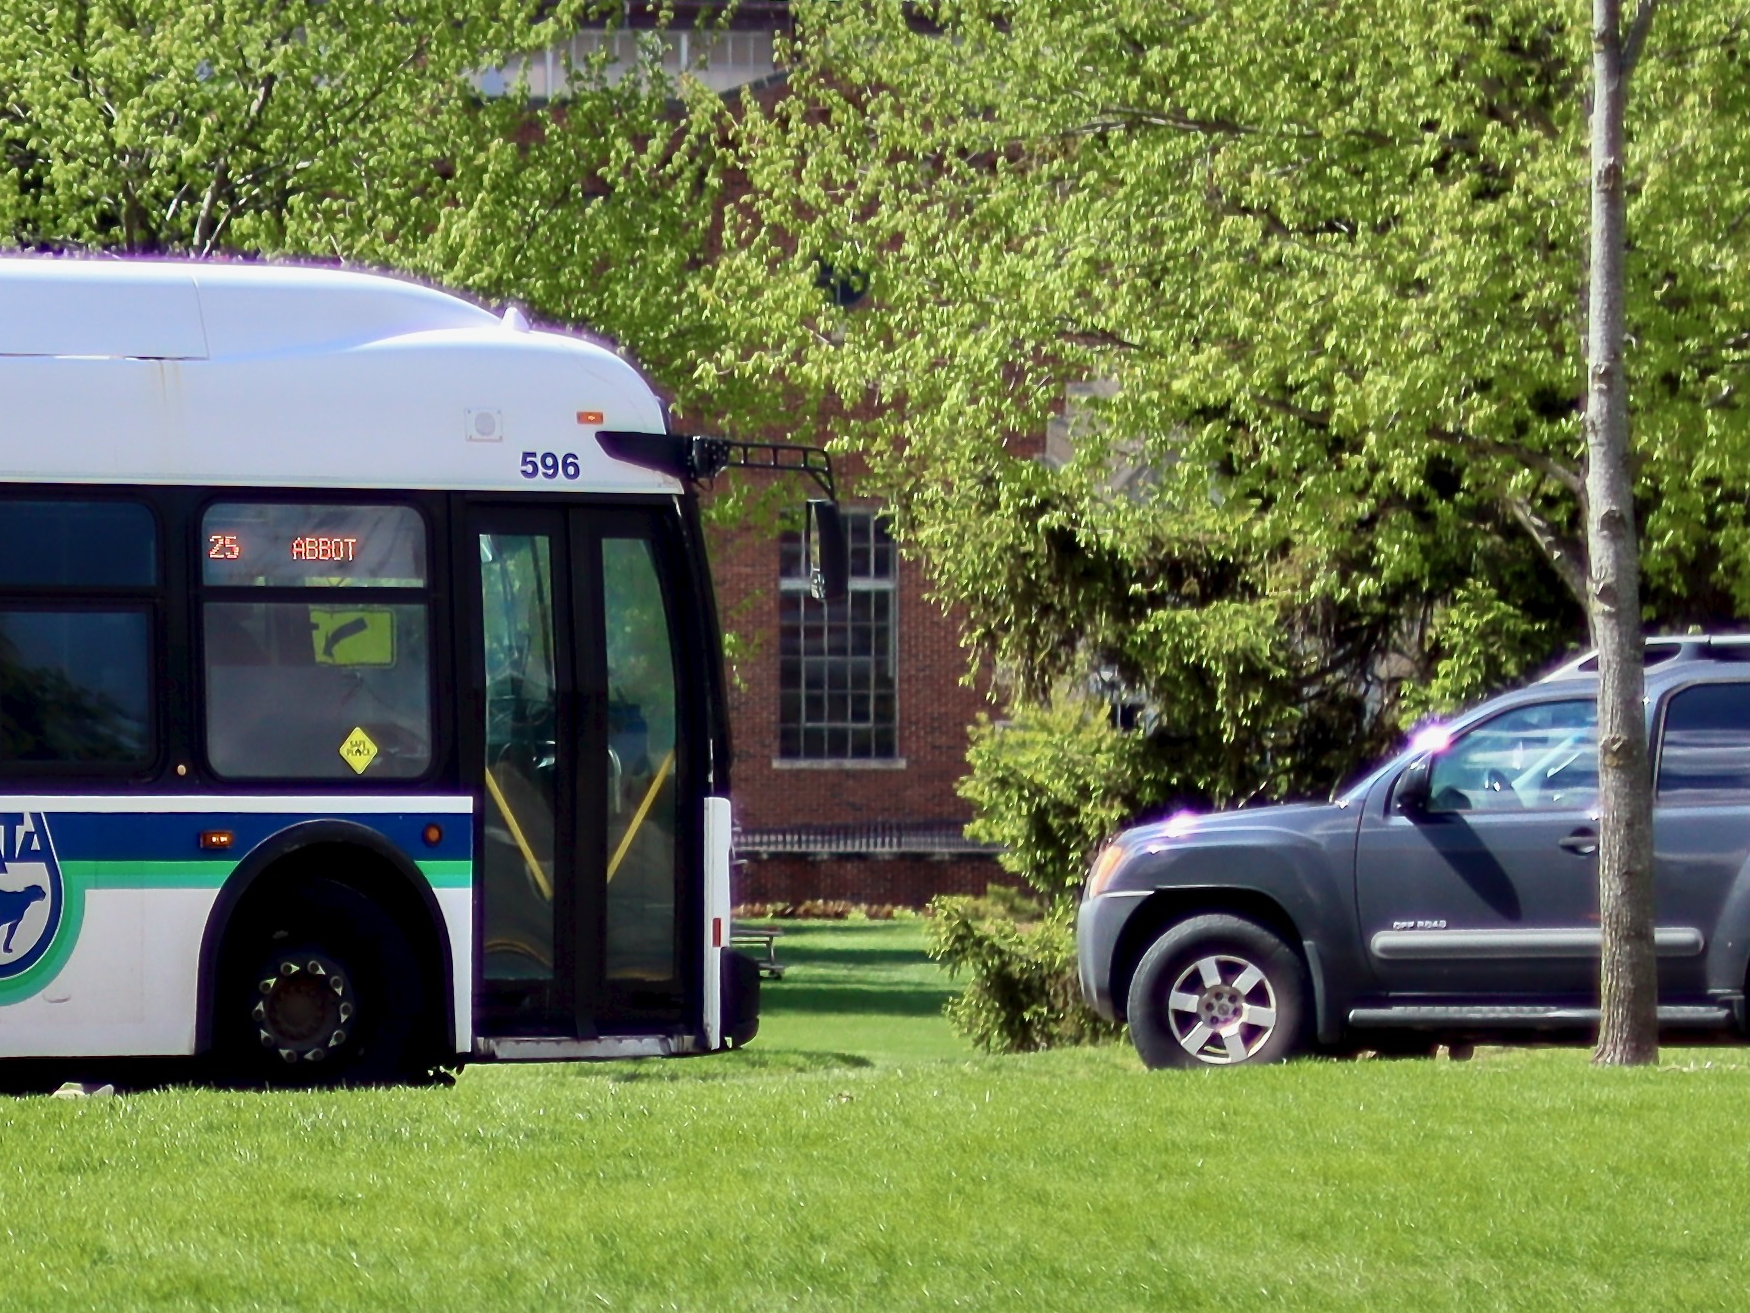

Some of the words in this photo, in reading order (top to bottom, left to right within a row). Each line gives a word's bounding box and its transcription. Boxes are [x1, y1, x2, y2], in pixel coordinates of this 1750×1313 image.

[520, 451, 580, 480] 596
[209, 536, 240, 559] 25
[292, 537, 357, 561] ABBOT
